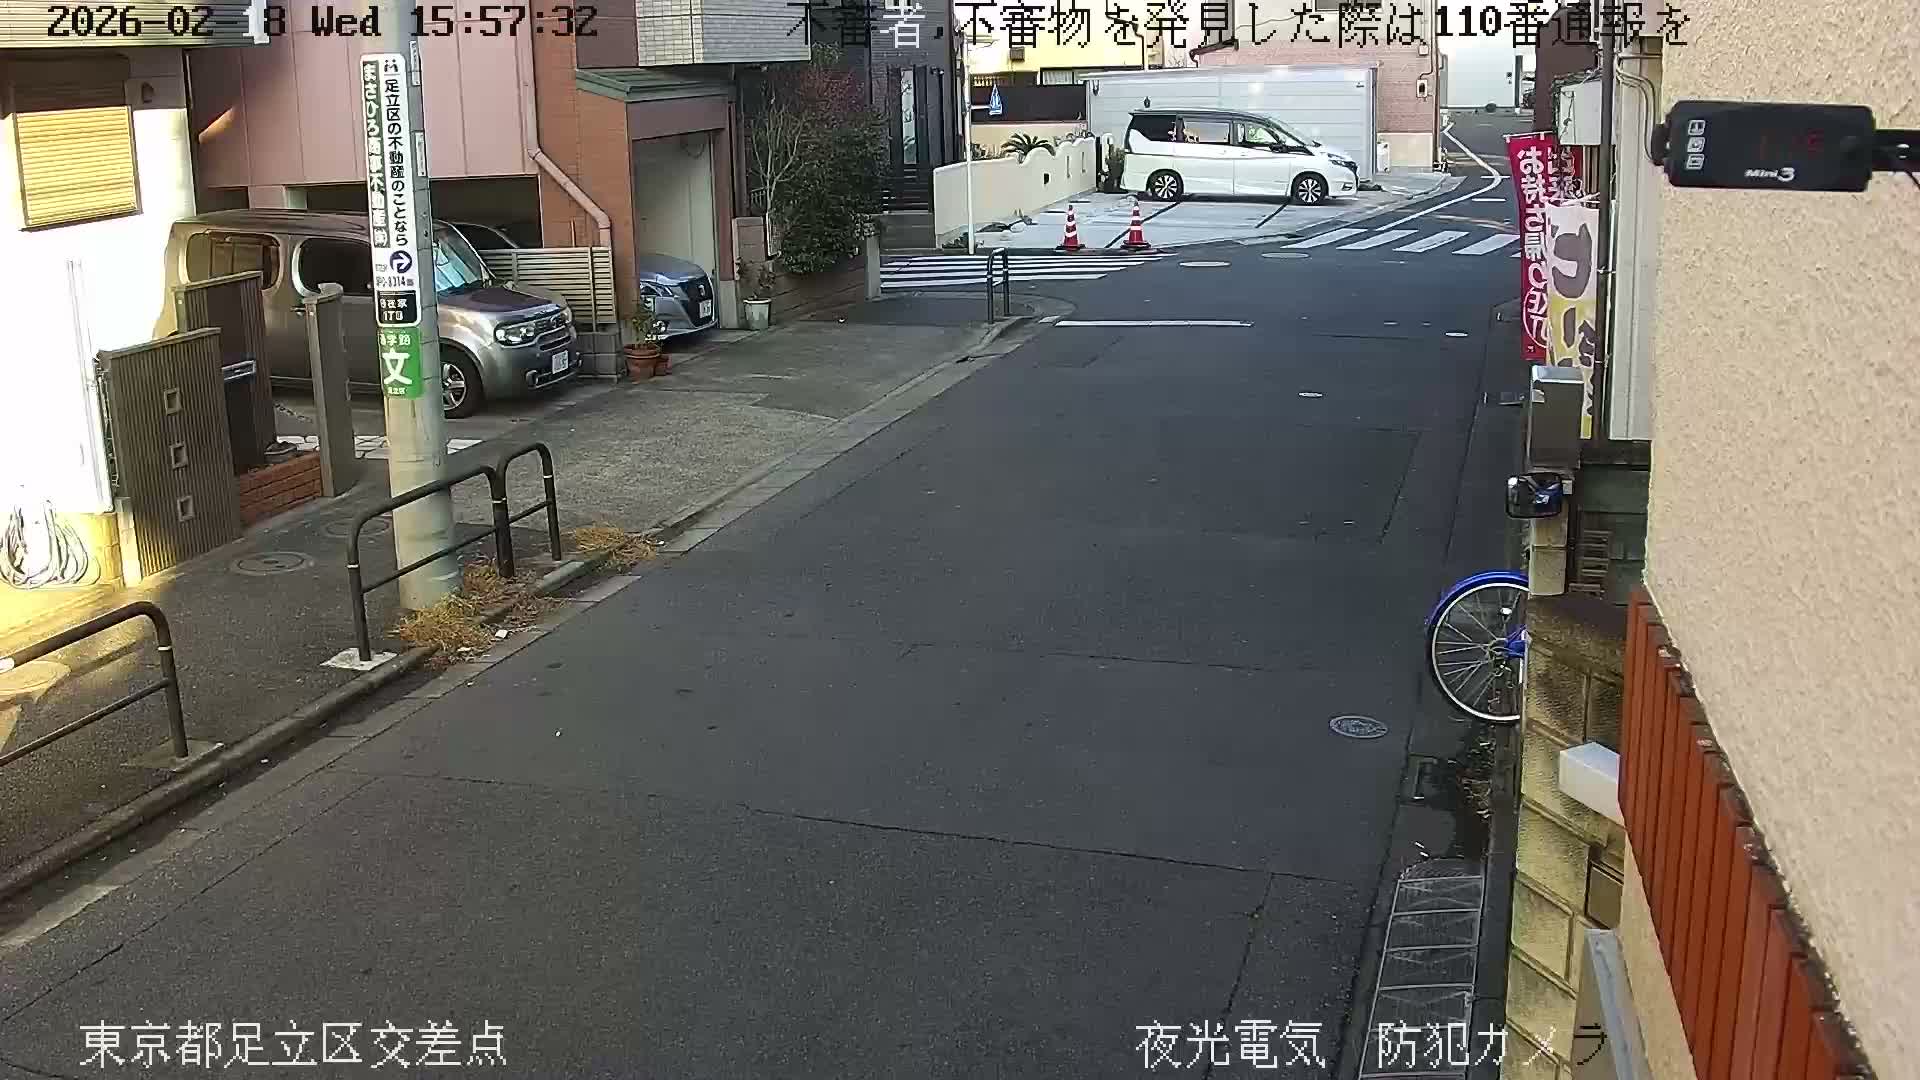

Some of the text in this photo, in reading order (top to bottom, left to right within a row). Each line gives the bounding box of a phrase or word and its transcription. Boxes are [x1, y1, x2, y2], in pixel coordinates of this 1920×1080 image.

[385, 79, 409, 247] 足立区の不動産のことなら
[381, 347, 413, 385] 文
